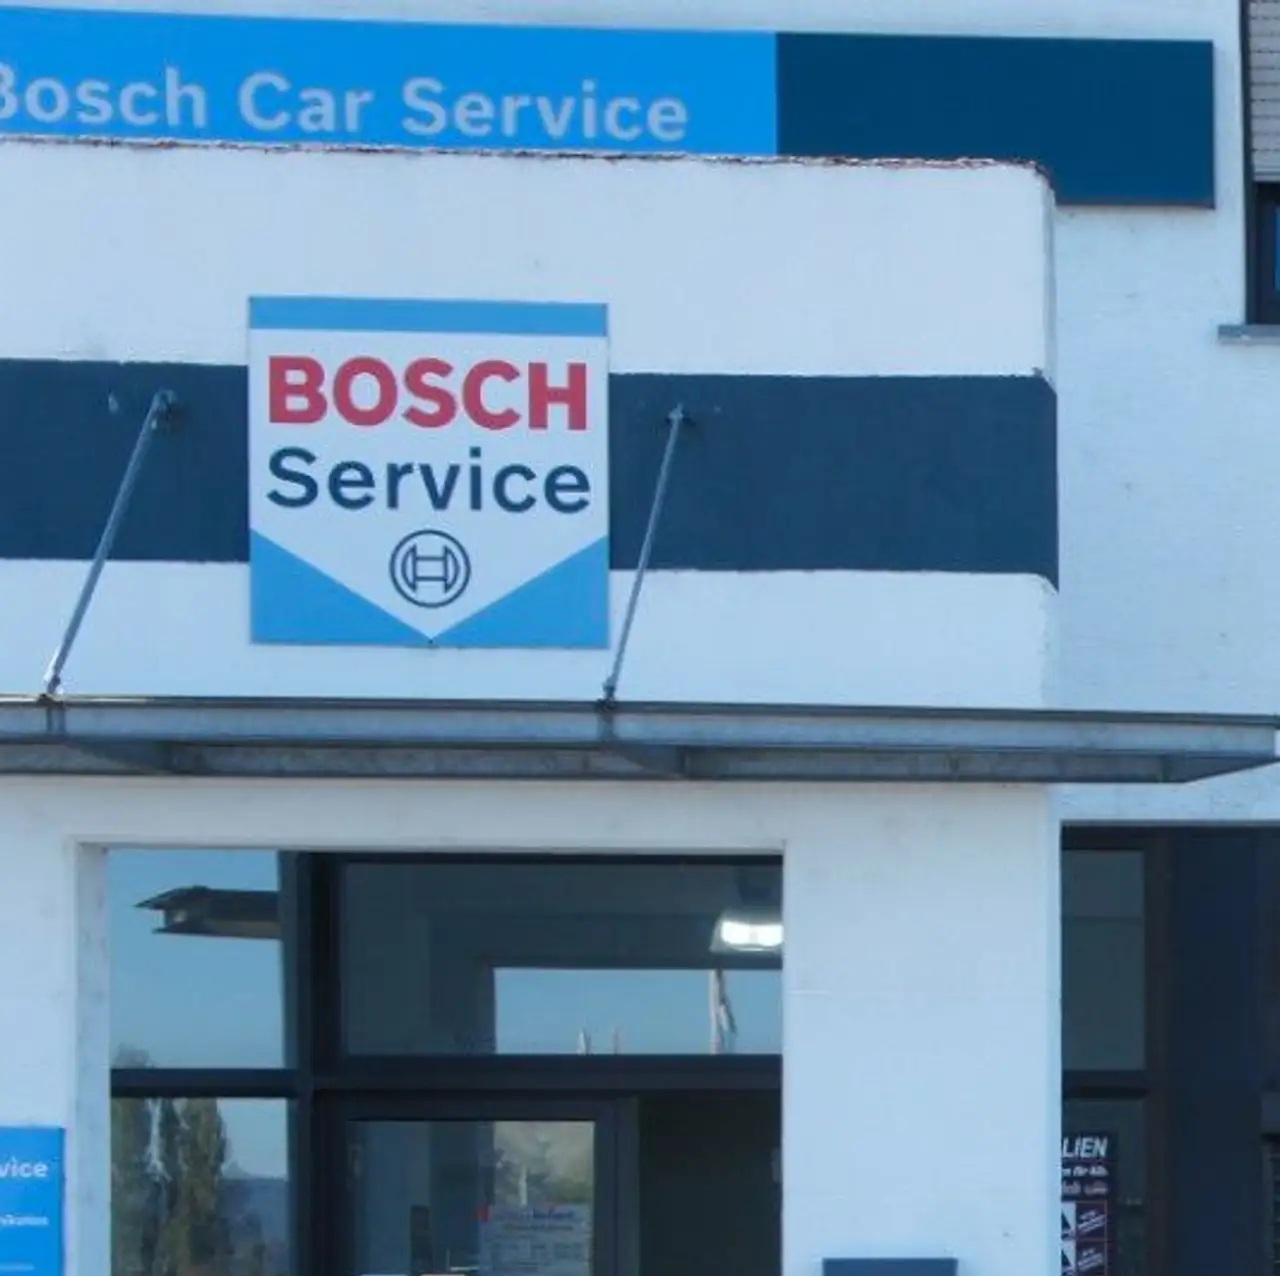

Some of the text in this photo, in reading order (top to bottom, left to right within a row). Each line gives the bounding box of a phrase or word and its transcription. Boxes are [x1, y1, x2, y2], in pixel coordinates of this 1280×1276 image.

[239, 71, 374, 132] Car
[402, 77, 688, 142] Service
[268, 355, 588, 431] BOSCH
[266, 446, 591, 514] Service
